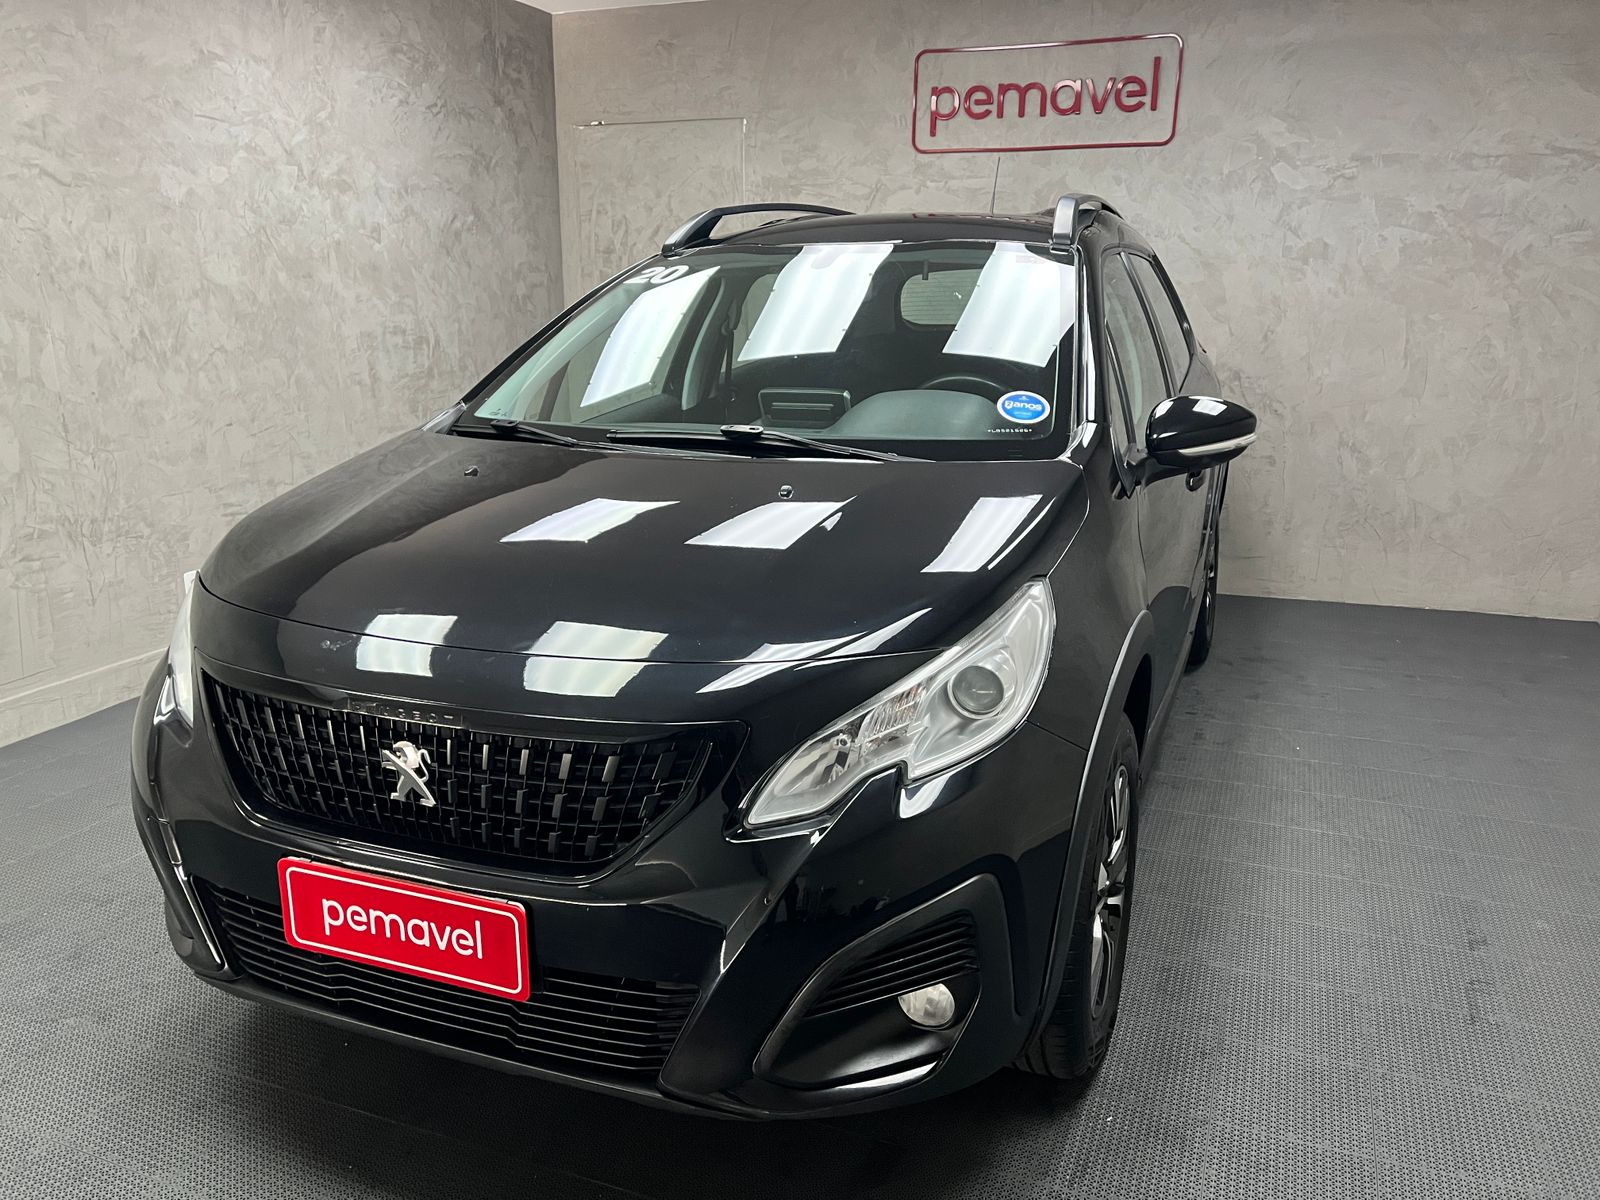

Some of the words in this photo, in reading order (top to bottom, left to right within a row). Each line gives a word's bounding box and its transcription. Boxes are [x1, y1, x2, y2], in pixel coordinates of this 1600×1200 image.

[929, 56, 1162, 137] pemavel
[622, 265, 690, 284] 20
[321, 898, 483, 960] pemavel
